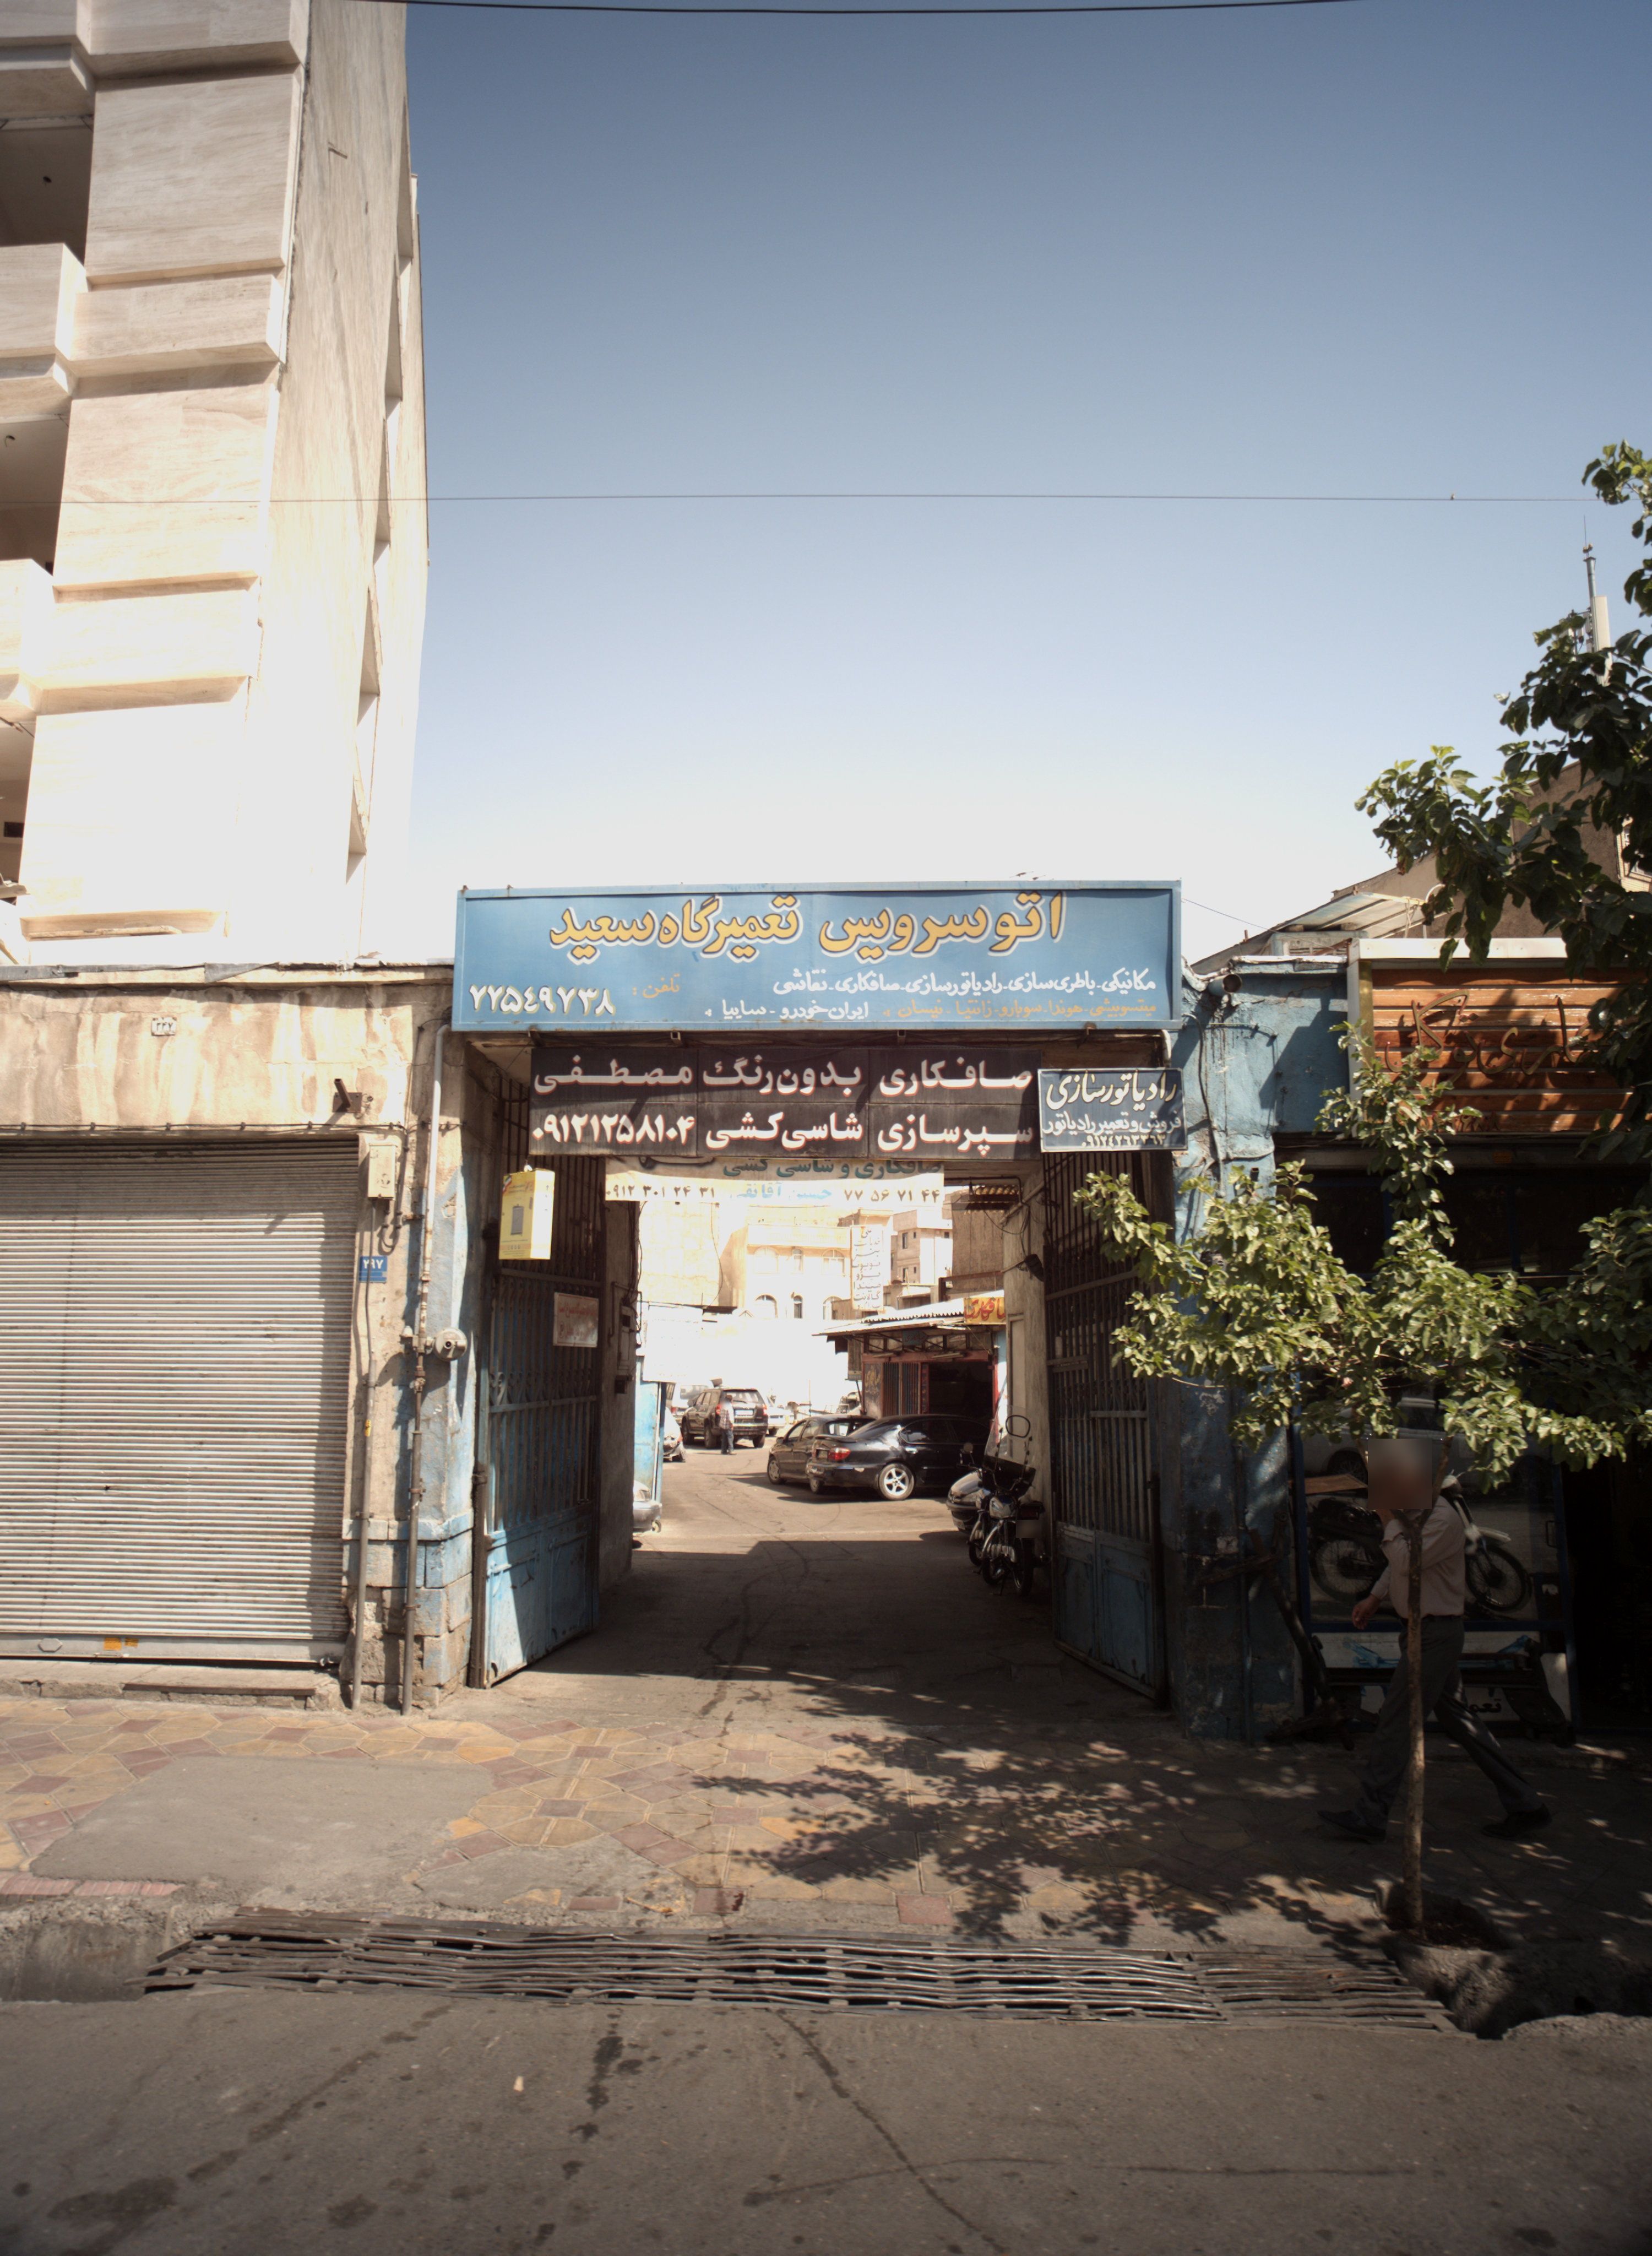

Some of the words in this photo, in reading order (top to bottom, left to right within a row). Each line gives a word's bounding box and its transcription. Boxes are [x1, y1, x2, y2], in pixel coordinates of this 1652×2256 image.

[550, 908, 659, 963] سعید
[658, 893, 803, 963] تعمیرگاه
[773, 968, 828, 995] نقاشی
[835, 970, 900, 994] صافکاری
[1101, 967, 1156, 994] مکانیکی
[722, 999, 767, 1019] سایپا
[898, 999, 942, 1018] نیسان
[955, 1000, 992, 1018] زانتیا
[998, 1000, 1042, 1017] سوبارو
[534, 1055, 693, 1095] مصطفی
[703, 1055, 773, 1095] رنگ
[776, 1061, 863, 1097] بدون
[879, 1056, 1032, 1097] صافکاری
[532, 1114, 695, 1146] ۰۹۱۲۱۲۵۸۱۰۴
[706, 1112, 784, 1150] کشی
[781, 1112, 863, 1151] شاسی
[1042, 1110, 1095, 1135] رادیاتور
[1094, 1111, 1129, 1135] تعمیر
[1139, 1110, 1182, 1134] فروش
[838, 1163, 850, 1178] و
[855, 1160, 942, 1179] صافکاری
[964, 1297, 1006, 1321] افکاری
